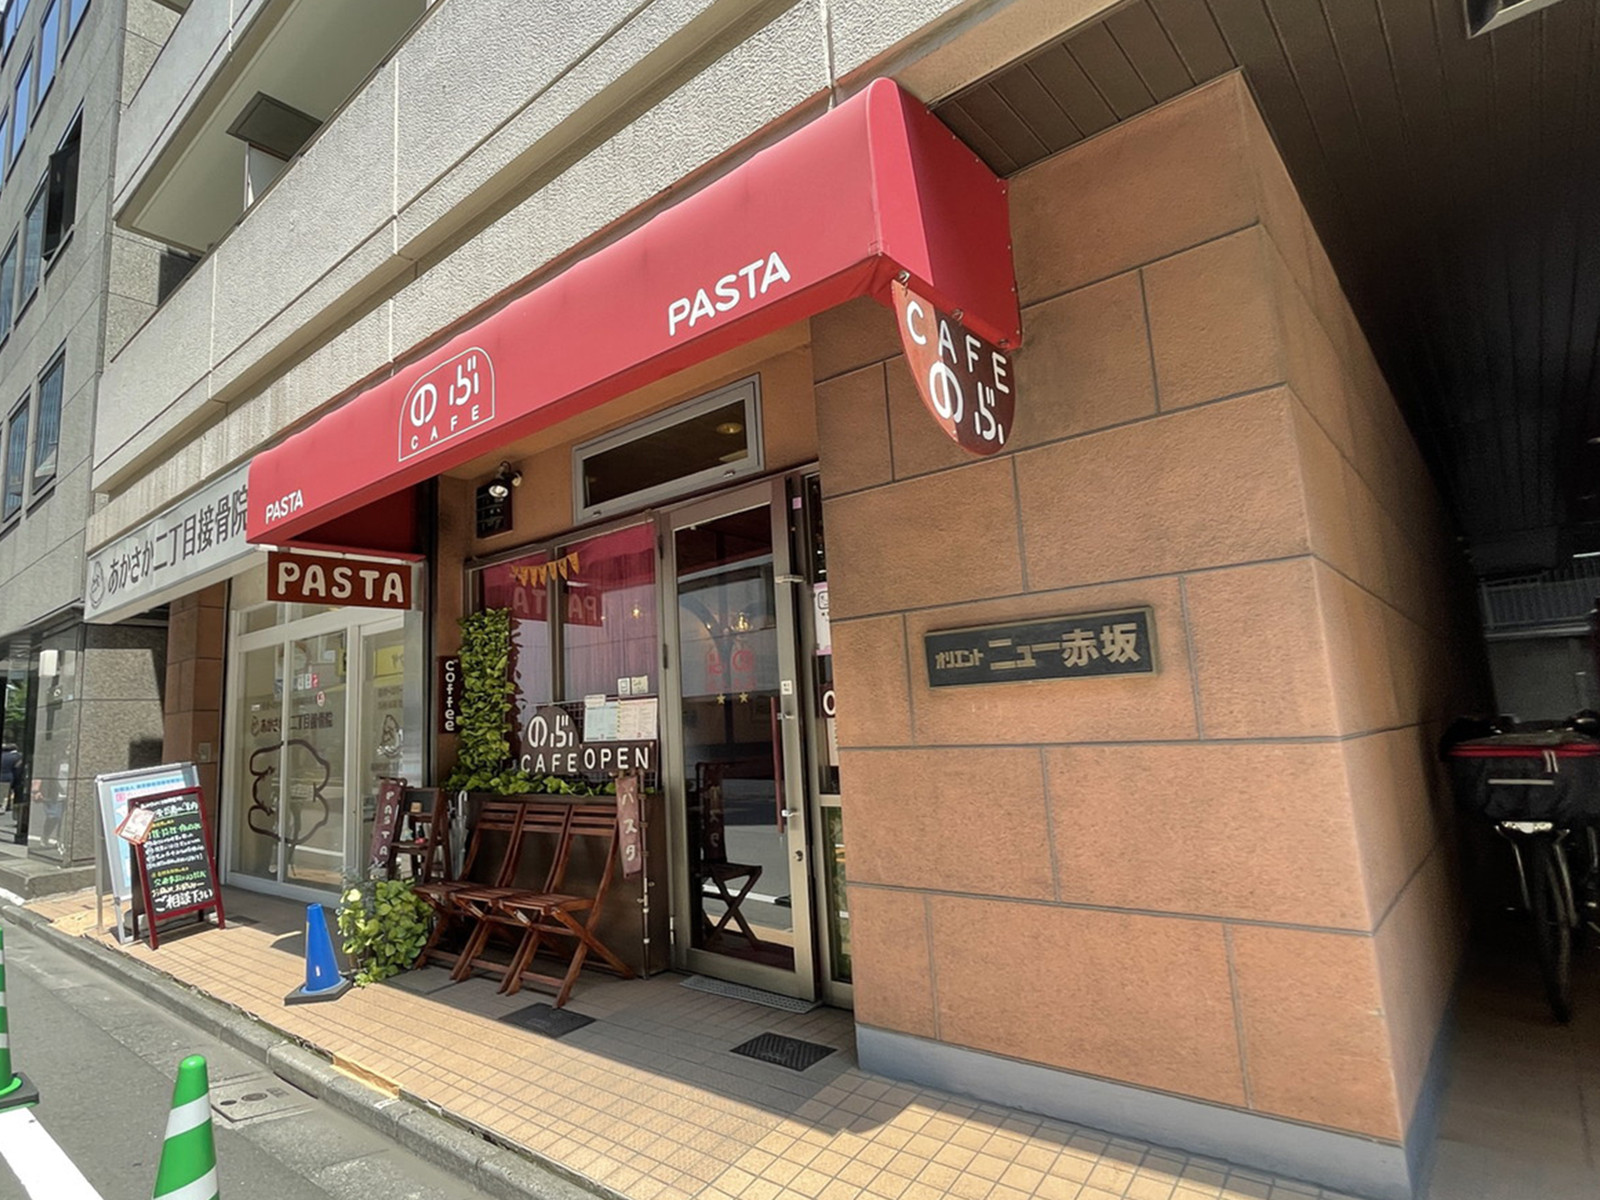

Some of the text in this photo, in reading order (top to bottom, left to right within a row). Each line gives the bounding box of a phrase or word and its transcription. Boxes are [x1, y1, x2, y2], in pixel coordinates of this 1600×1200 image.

[668, 251, 791, 336] PASTA
[906, 300, 1010, 394] CAFE
[411, 356, 480, 427] のぶ
[929, 360, 1004, 445] のぶ
[410, 405, 480, 450] CAFE
[265, 489, 304, 524] PASTA
[107, 485, 247, 595] あかさか二丁目接骨院
[278, 561, 404, 603] PASTA
[521, 746, 649, 773] CAFE OPEN
[528, 714, 574, 748] のぶ
[379, 790, 395, 856] PASTA
